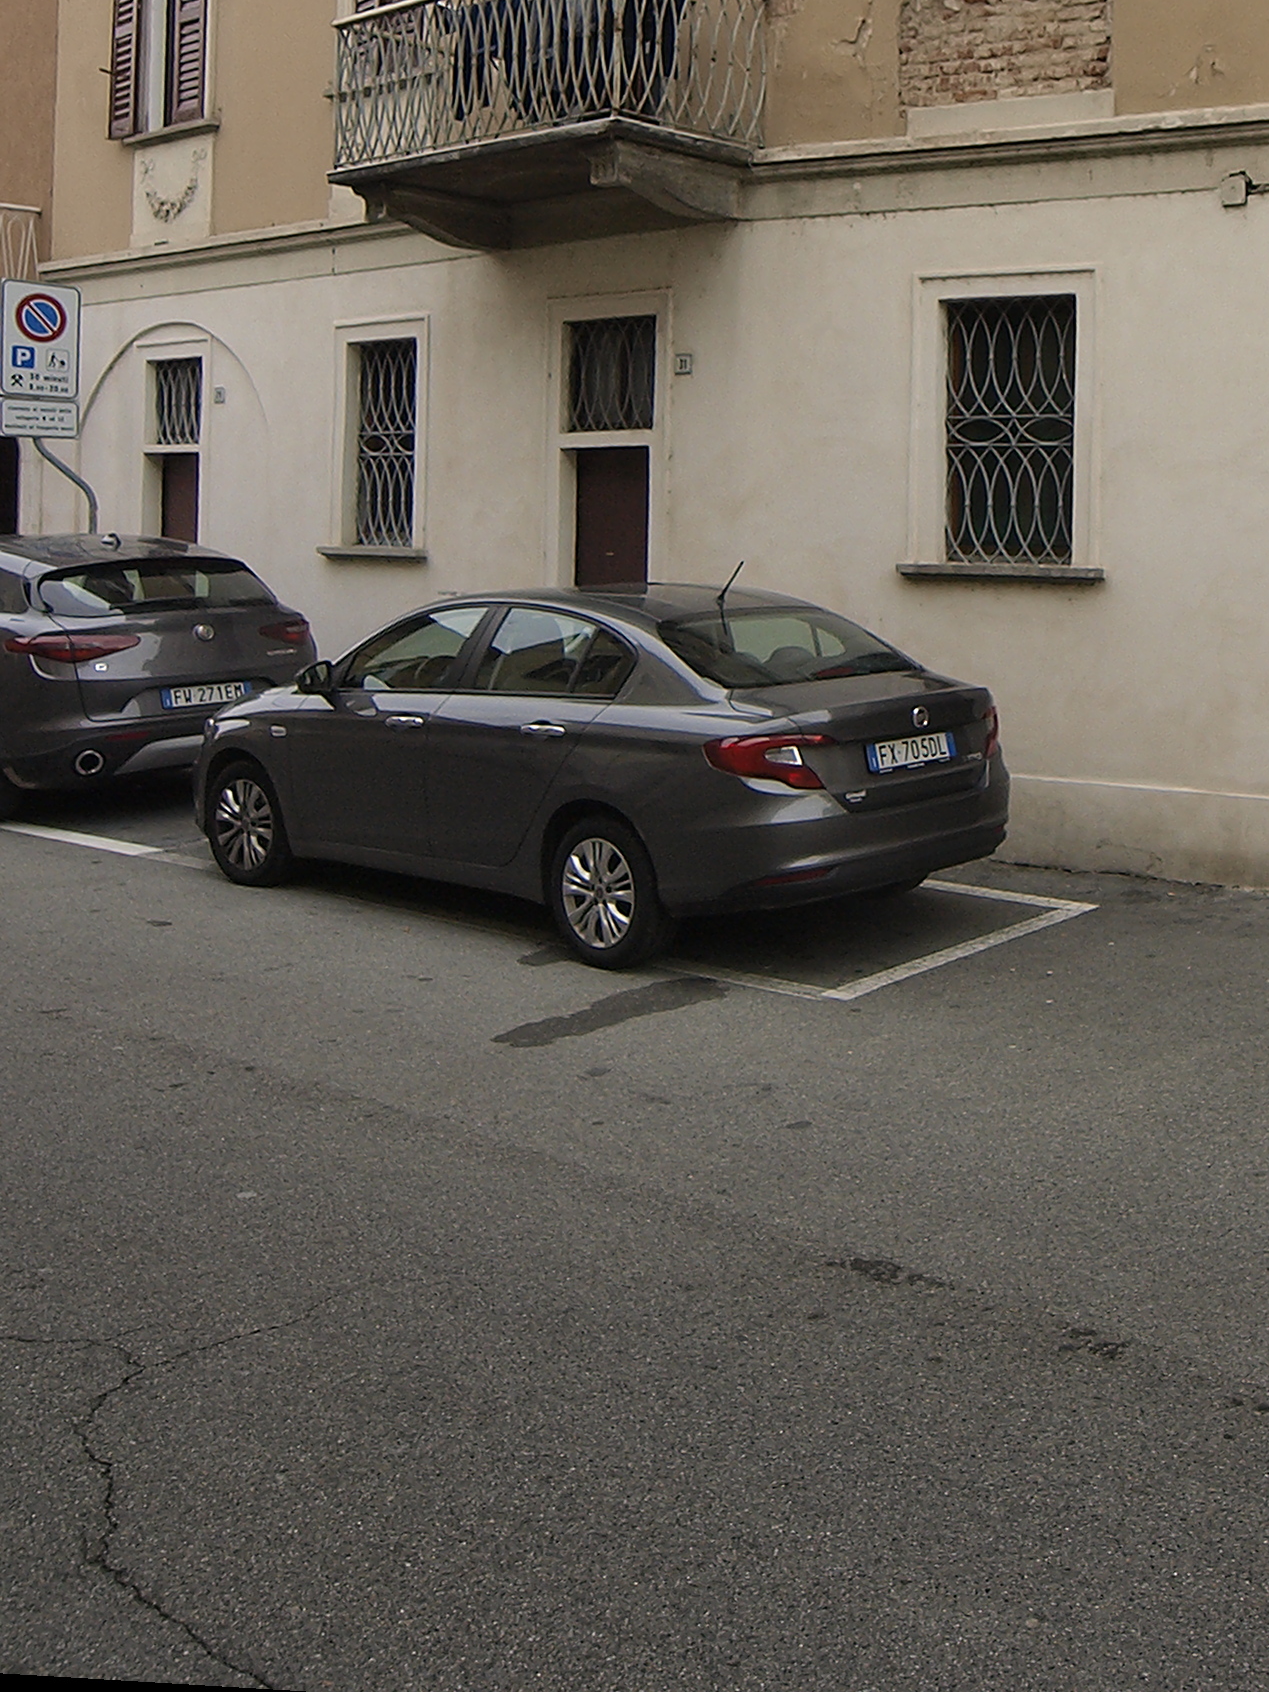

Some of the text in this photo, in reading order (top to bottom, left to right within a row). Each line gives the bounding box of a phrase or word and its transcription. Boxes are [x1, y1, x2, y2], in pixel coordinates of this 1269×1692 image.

[16, 348, 31, 366] P
[879, 736, 947, 766] FX 705DL
